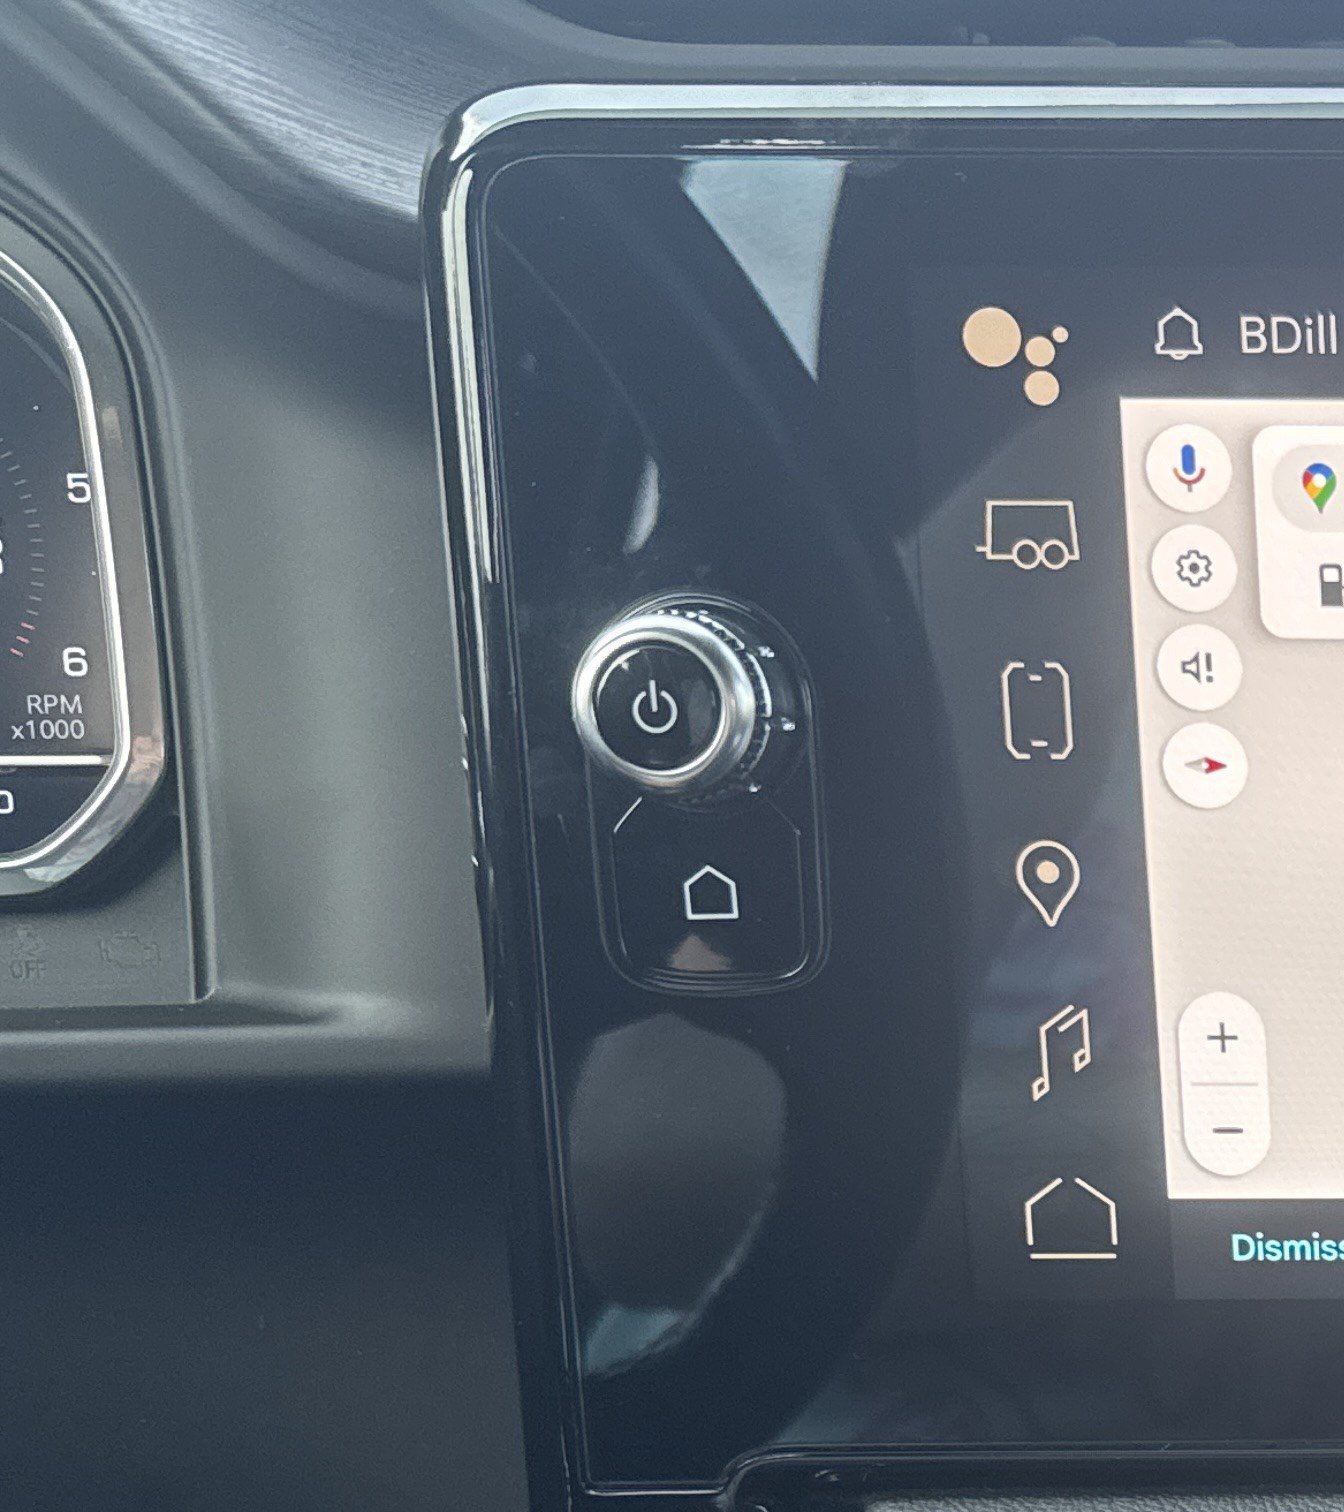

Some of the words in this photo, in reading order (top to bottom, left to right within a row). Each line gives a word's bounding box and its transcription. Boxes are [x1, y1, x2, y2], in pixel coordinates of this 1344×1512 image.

[1239, 312, 1340, 356] BDill
[66, 473, 91, 503] 5
[62, 646, 88, 677] 6
[26, 693, 83, 715] RPM
[11, 719, 85, 740] x1000
